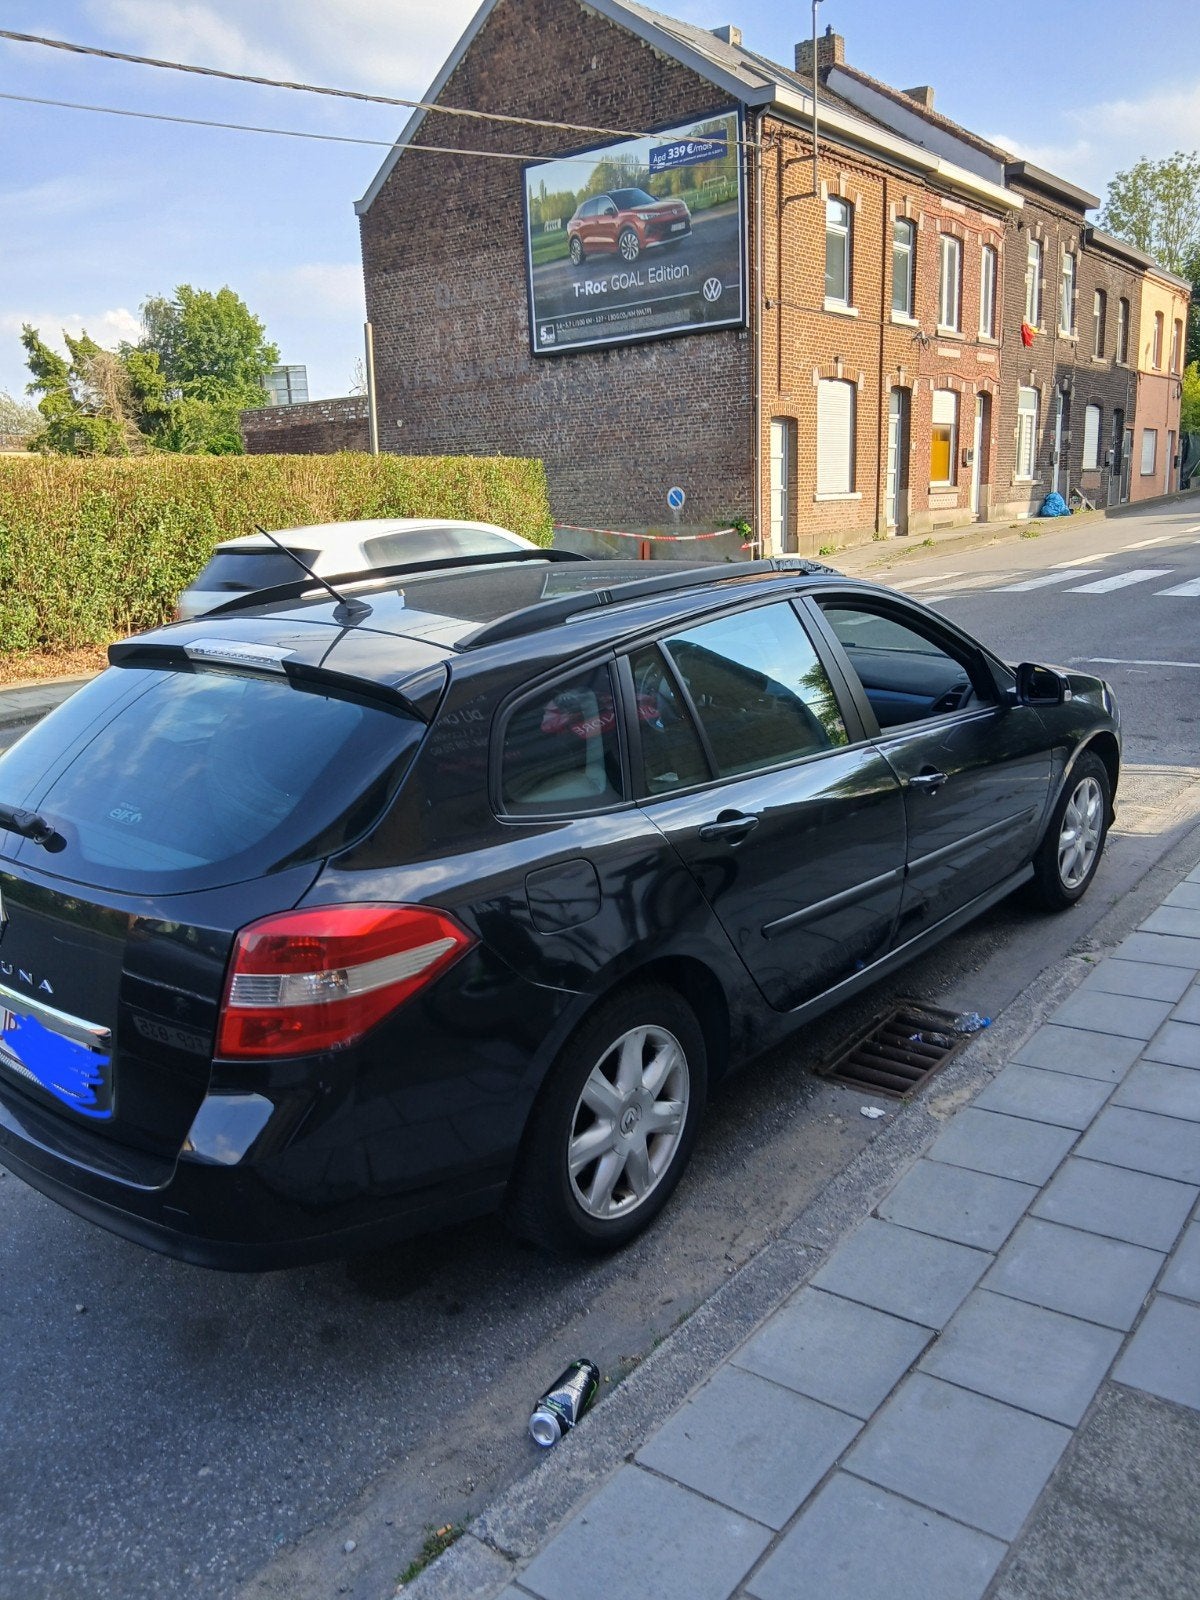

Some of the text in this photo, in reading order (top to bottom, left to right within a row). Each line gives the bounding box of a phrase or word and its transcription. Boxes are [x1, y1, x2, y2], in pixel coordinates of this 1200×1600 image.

[668, 145, 685, 159] 339
[573, 264, 690, 298] T-Roc GOAL Edition
